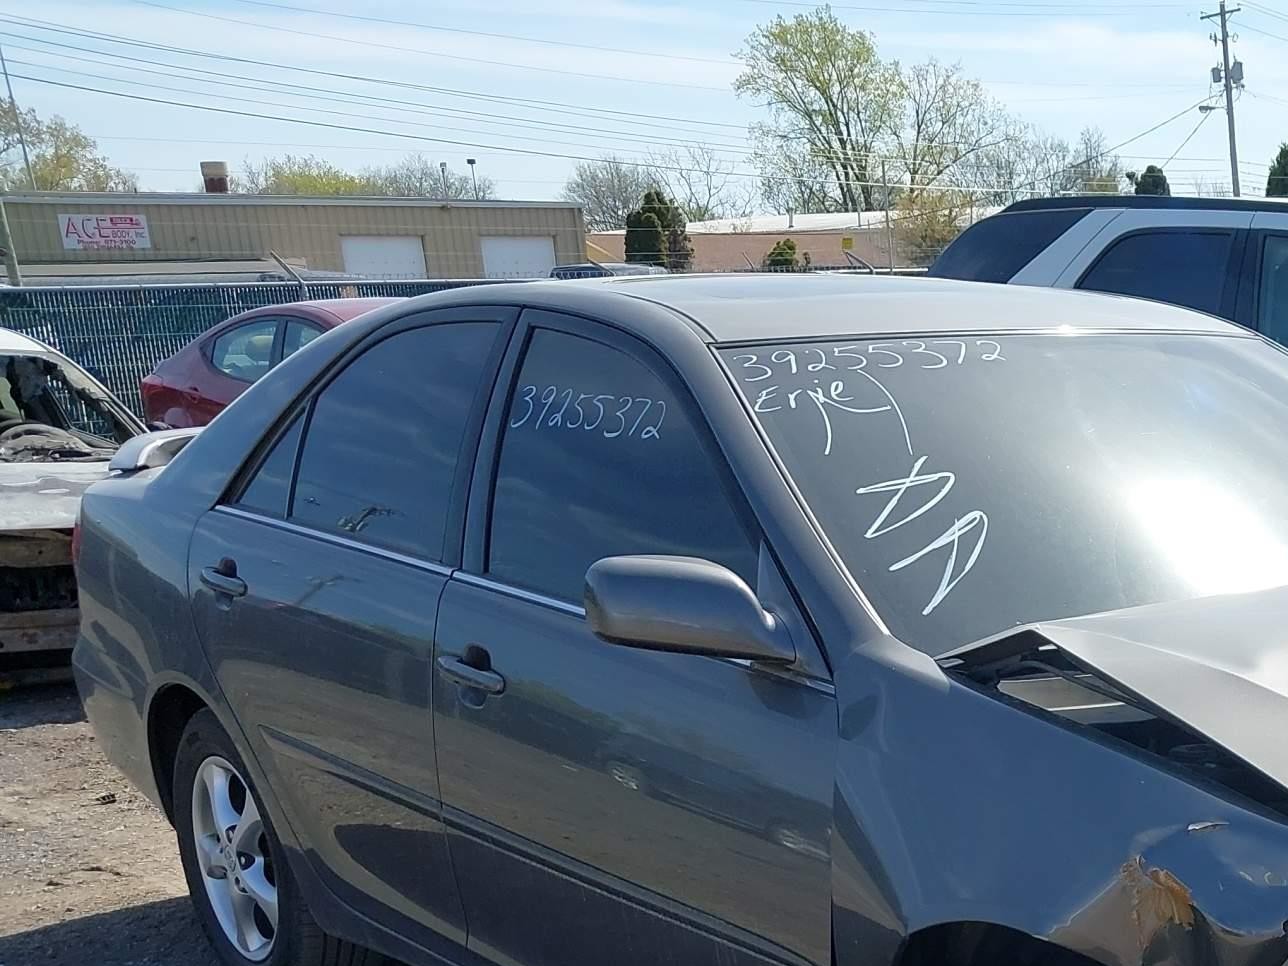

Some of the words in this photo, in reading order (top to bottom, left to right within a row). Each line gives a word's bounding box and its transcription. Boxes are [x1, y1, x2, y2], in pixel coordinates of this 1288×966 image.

[65, 217, 110, 240] ACE
[732, 340, 1007, 382] 39255372
[510, 383, 667, 440] 39255372
